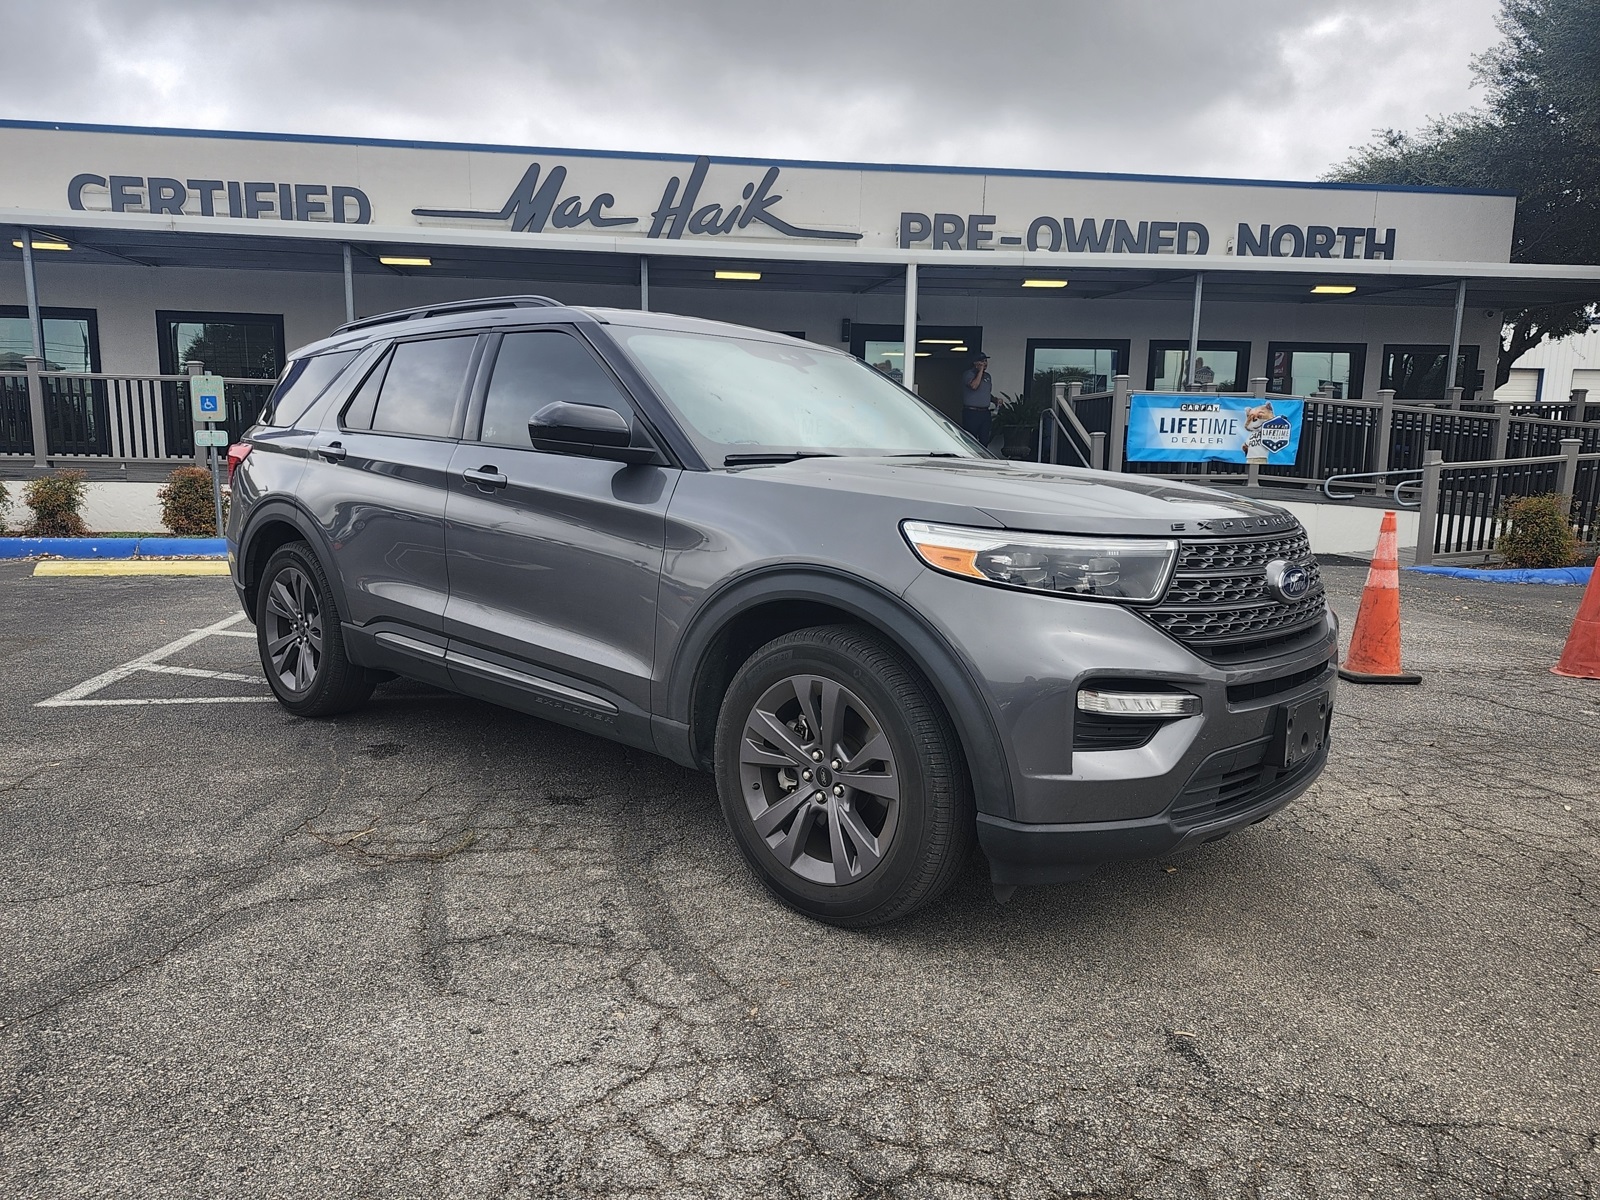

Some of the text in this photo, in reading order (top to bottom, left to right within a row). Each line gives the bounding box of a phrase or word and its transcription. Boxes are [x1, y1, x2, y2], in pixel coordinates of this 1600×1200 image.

[67, 173, 372, 224] CERTIFIED
[411, 155, 863, 239] Mac Haik
[899, 212, 1396, 260] PRE-OWNED NORTH
[1180, 404, 1220, 412] CARFAX
[1159, 417, 1238, 436] LIFETIME
[1262, 429, 1289, 437] LIFETIME
